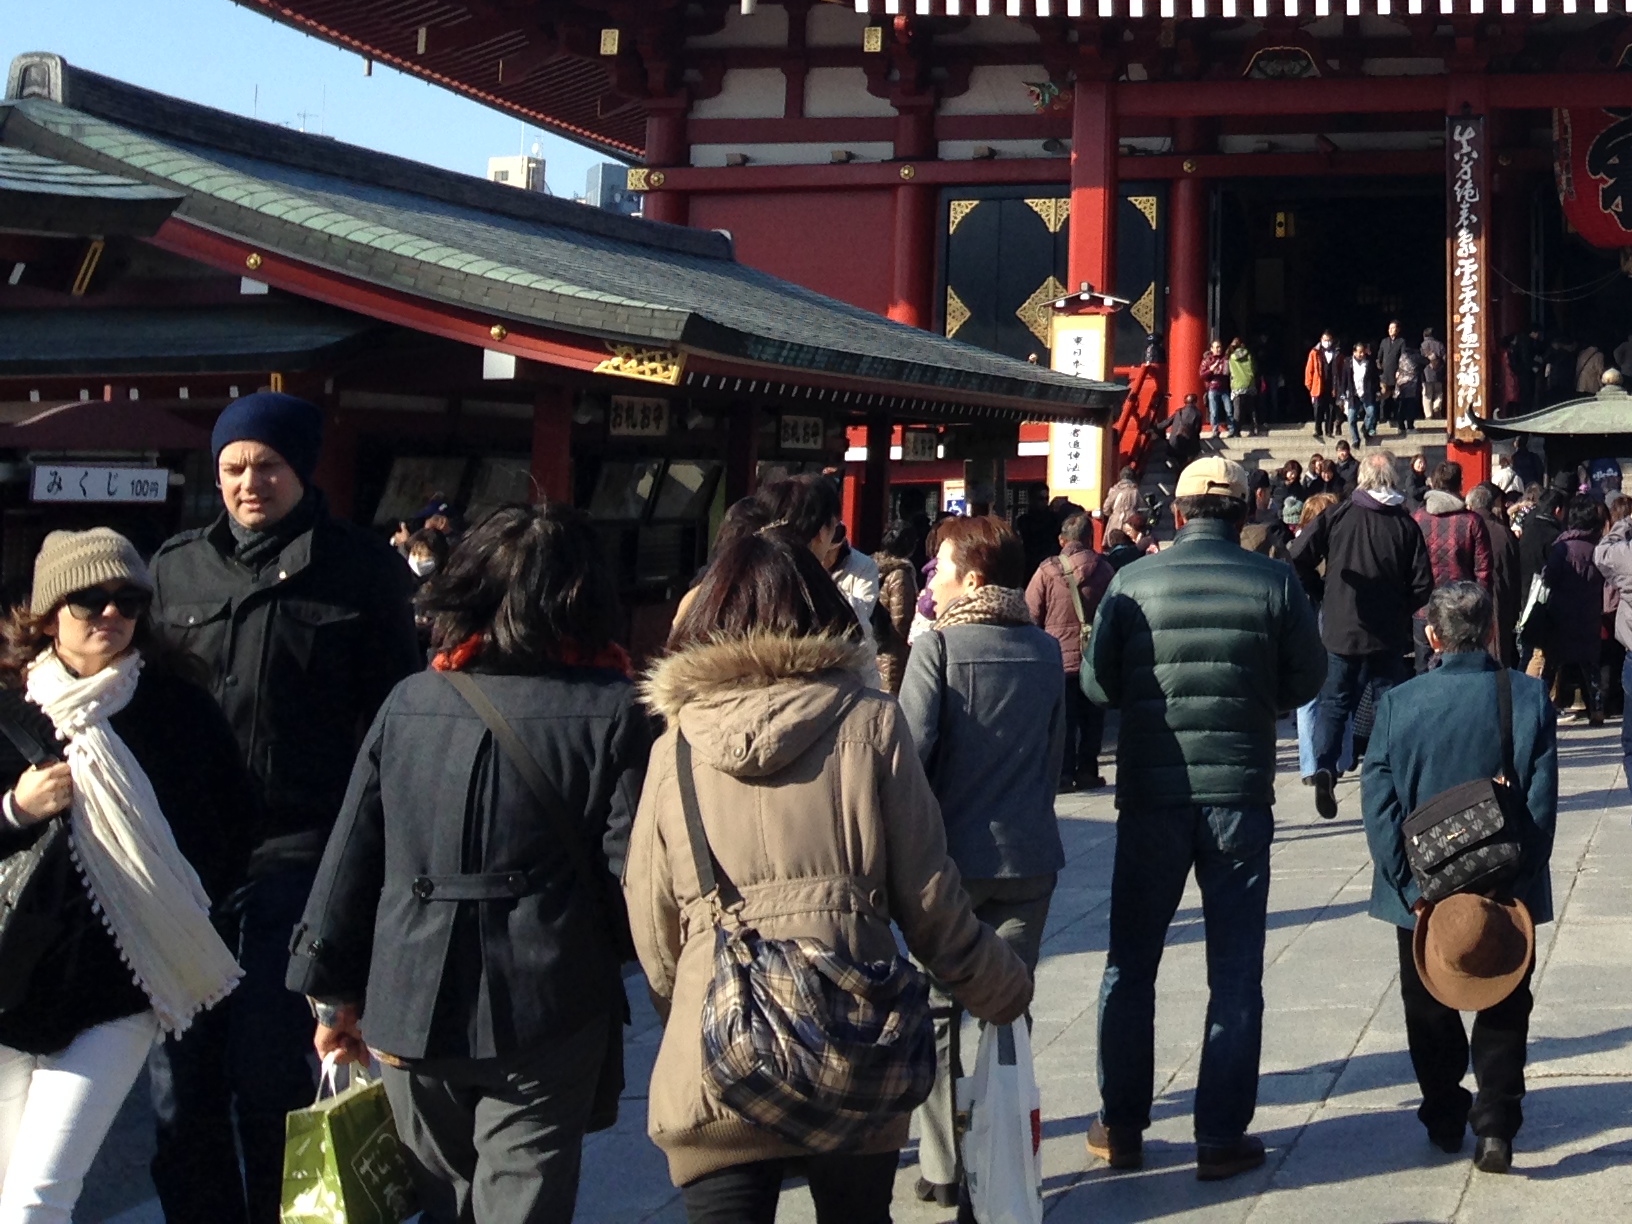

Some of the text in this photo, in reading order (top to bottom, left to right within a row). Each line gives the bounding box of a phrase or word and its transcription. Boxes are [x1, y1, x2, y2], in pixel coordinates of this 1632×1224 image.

[1072, 335, 1086, 376] 東日本
[47, 470, 159, 498] みくじ 100円
